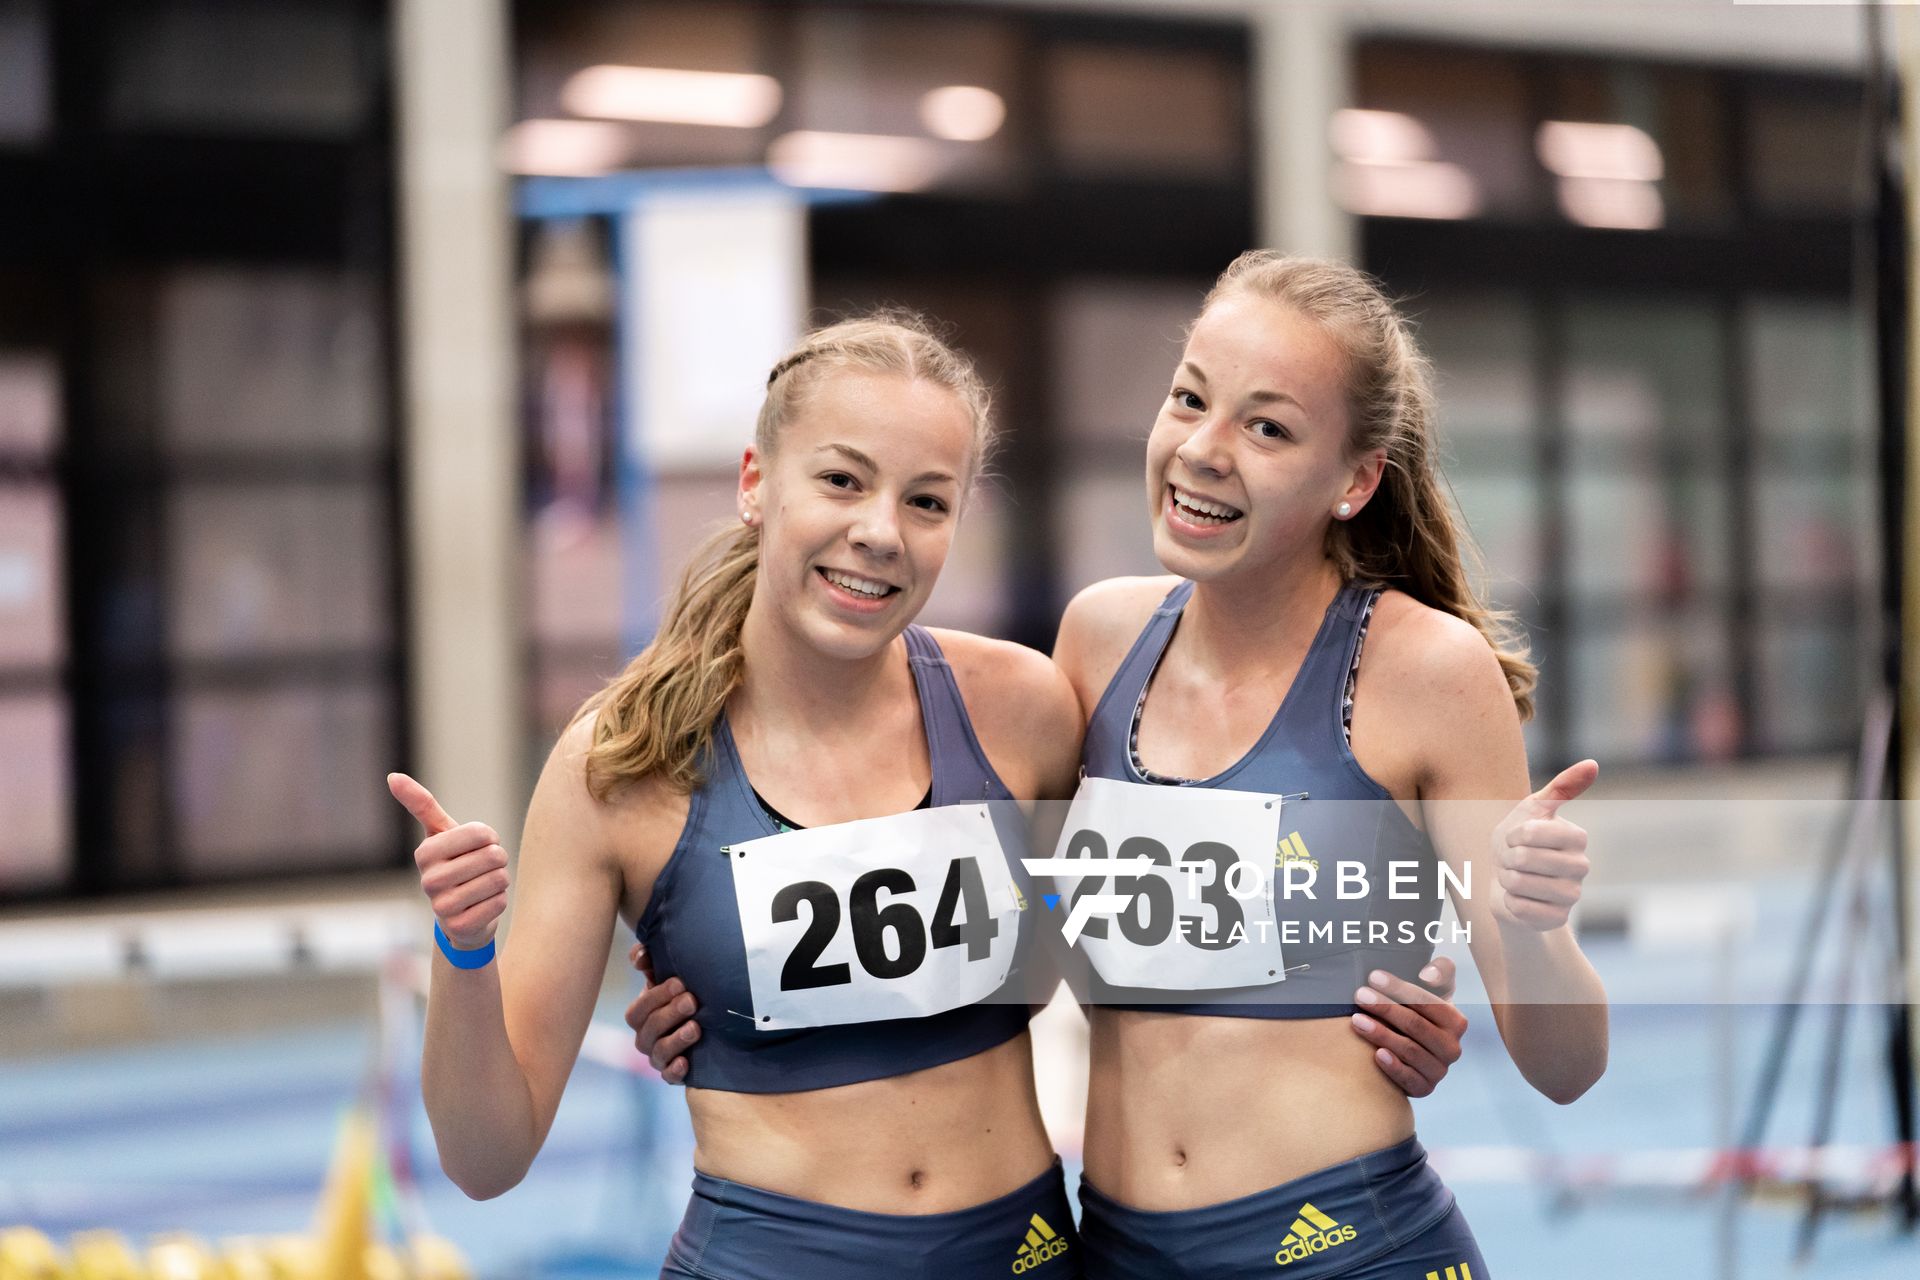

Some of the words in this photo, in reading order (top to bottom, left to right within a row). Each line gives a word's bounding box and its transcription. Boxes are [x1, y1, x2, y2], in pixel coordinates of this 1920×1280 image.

[1274, 852, 1319, 871] dds
[1065, 829, 1245, 950] 263
[771, 855, 999, 991] 264
[1012, 1236, 1069, 1274] adidas
[1275, 1224, 1357, 1265] adidas
